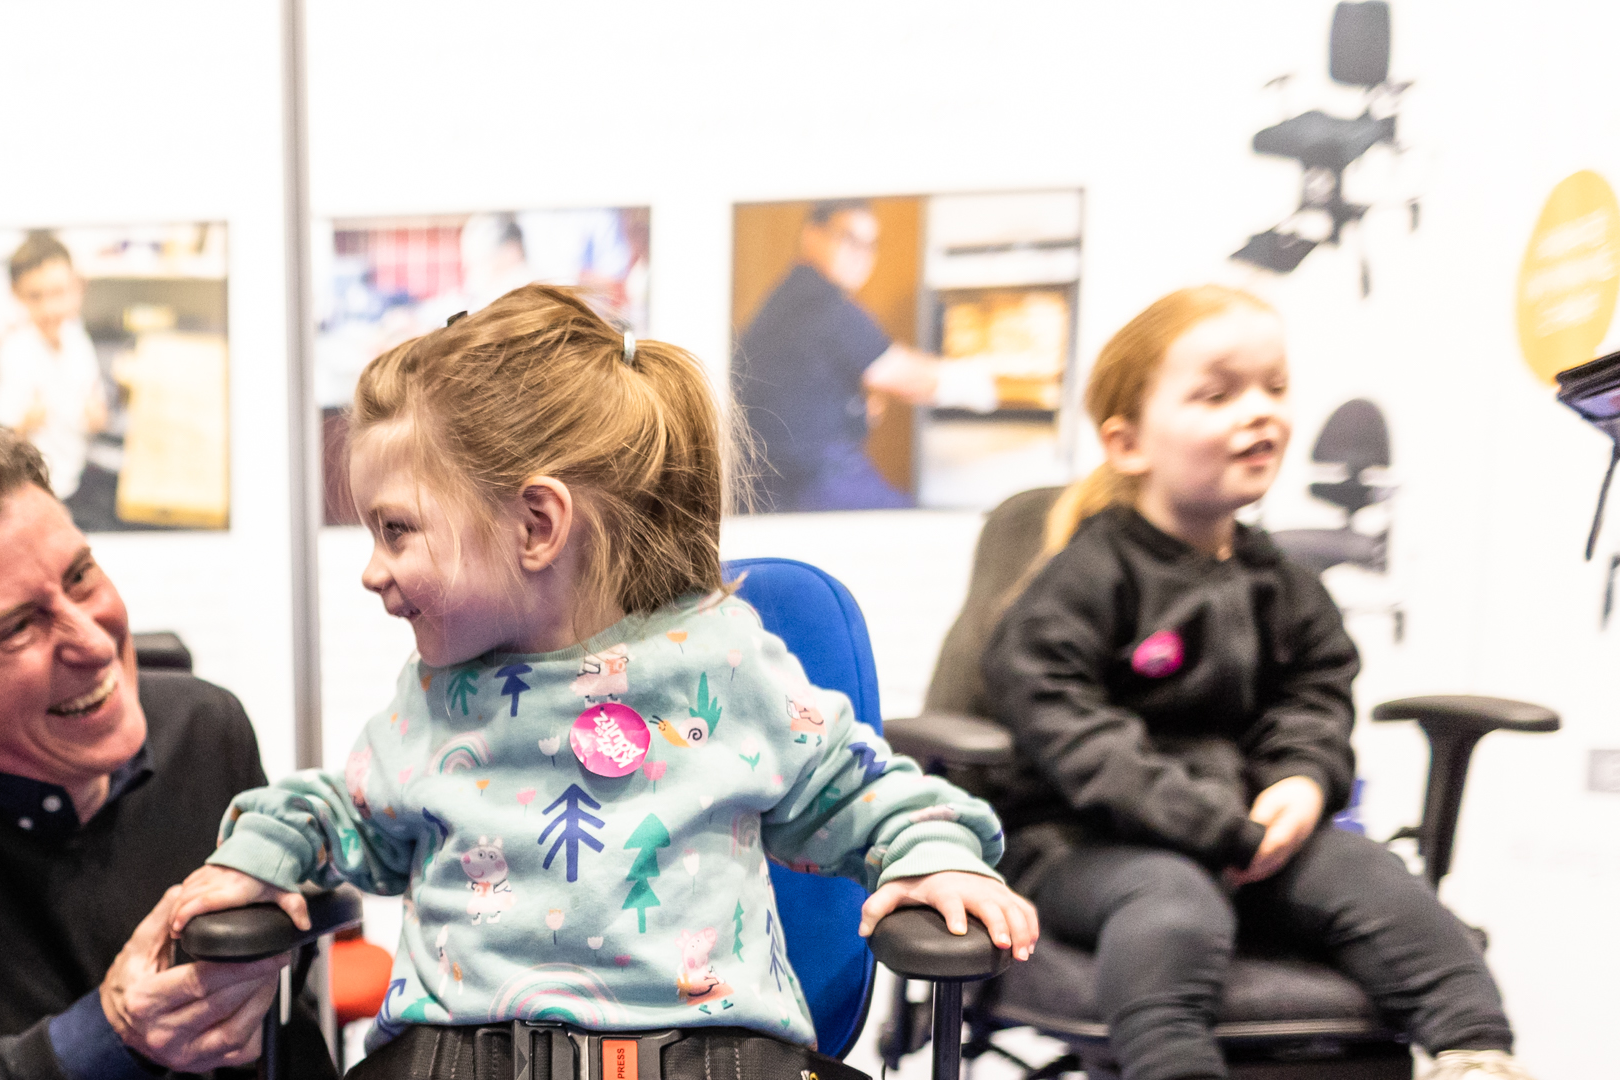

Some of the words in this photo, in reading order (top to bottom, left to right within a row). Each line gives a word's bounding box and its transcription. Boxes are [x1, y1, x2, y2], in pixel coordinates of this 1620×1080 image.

[593, 711, 645, 759] Adultz
[596, 734, 634, 768] Kidz
[617, 1047, 625, 1079] PRESS
